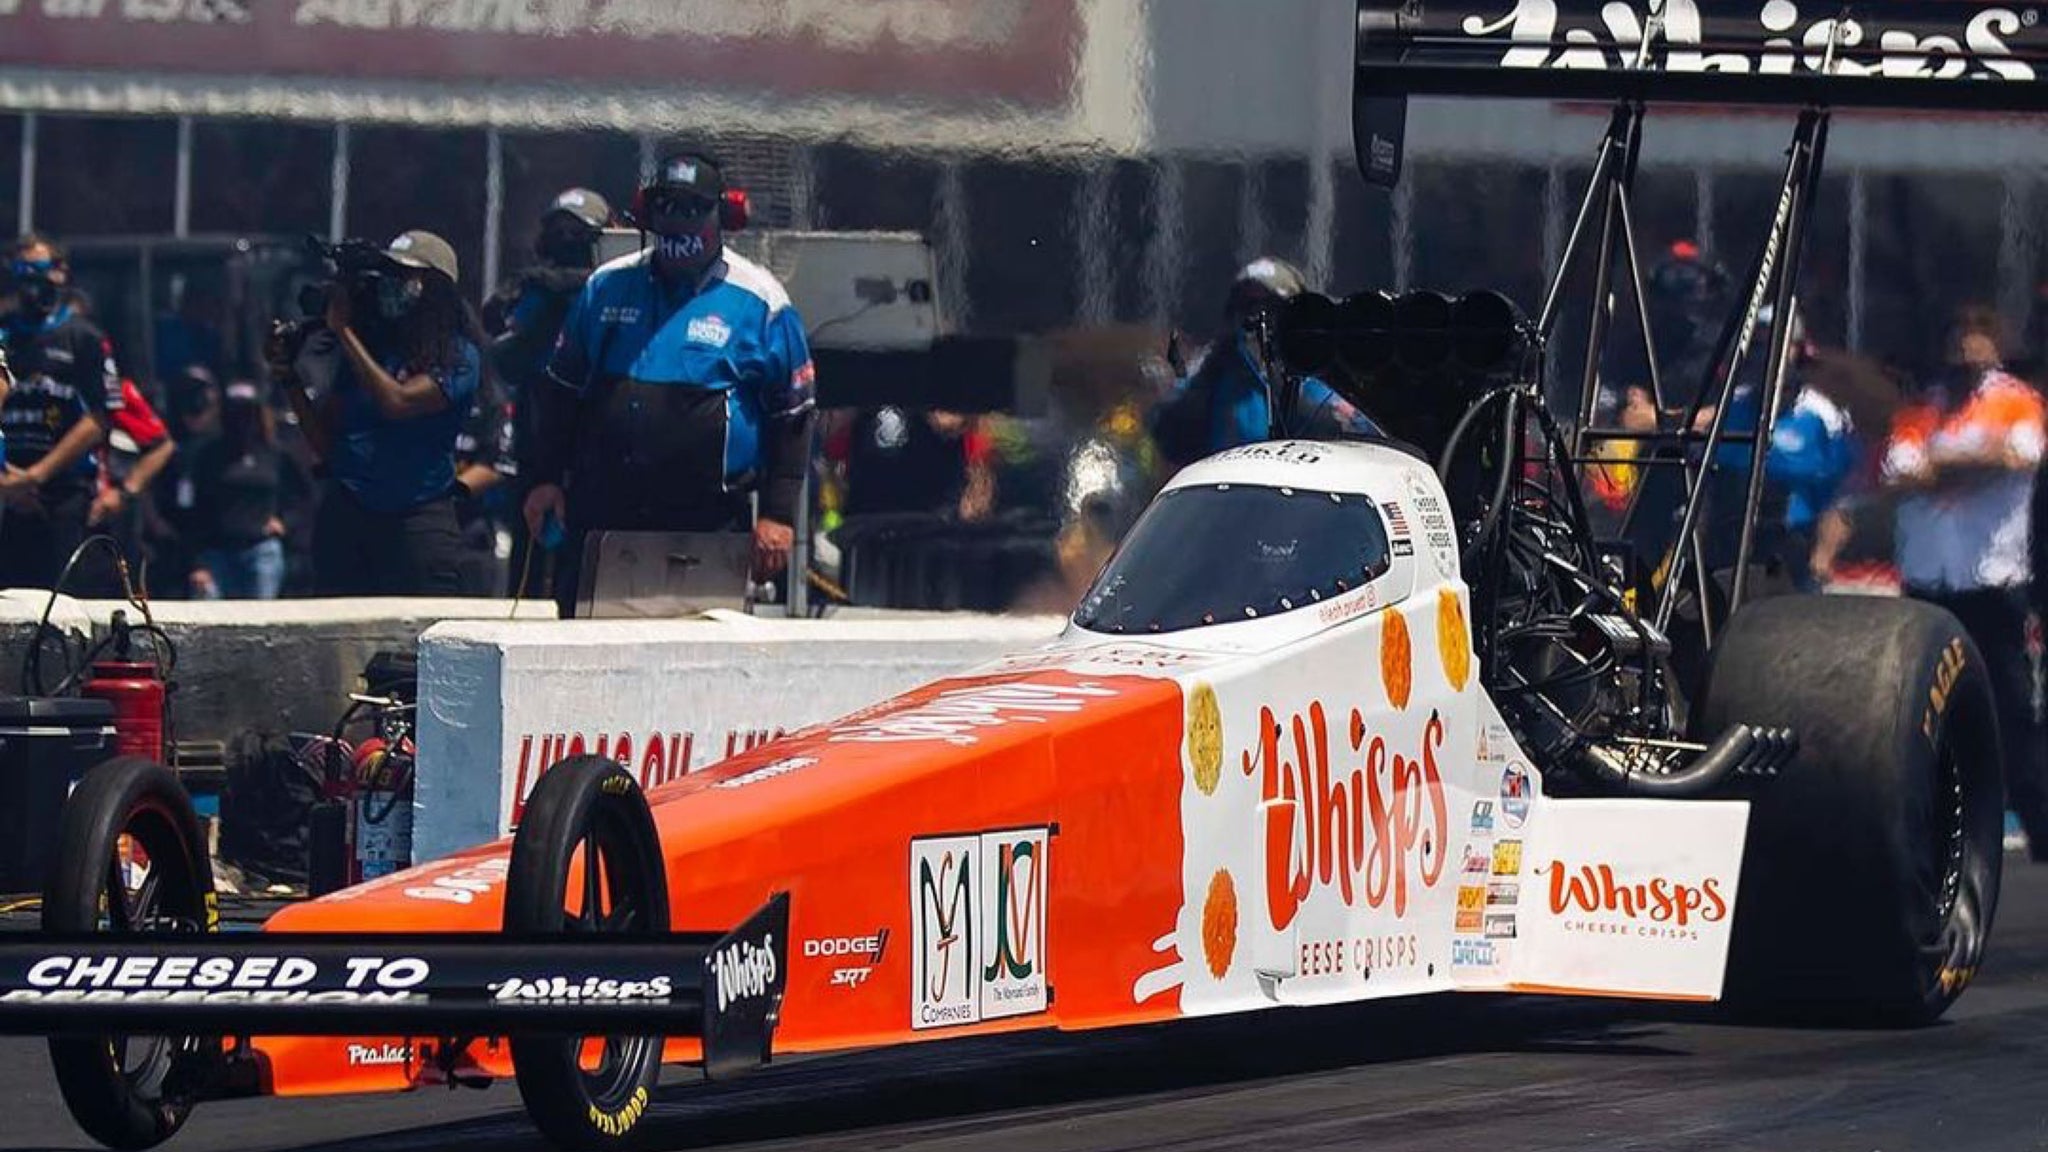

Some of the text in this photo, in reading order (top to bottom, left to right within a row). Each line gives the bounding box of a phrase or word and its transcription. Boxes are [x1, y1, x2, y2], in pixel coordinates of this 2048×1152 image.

[1923, 637, 1965, 737] EAGLE
[1243, 700, 1447, 930] Whisps
[1534, 860, 1726, 926] Whisps
[803, 936, 879, 957] DODGE
[1564, 920, 1699, 941] CHEESE CRISPS
[1353, 935, 1417, 971] CRISPS
[27, 956, 430, 989] CHEESED TO
[706, 933, 776, 1012] Whisps
[830, 967, 872, 989] SRT
[487, 976, 673, 1004] Whisps
